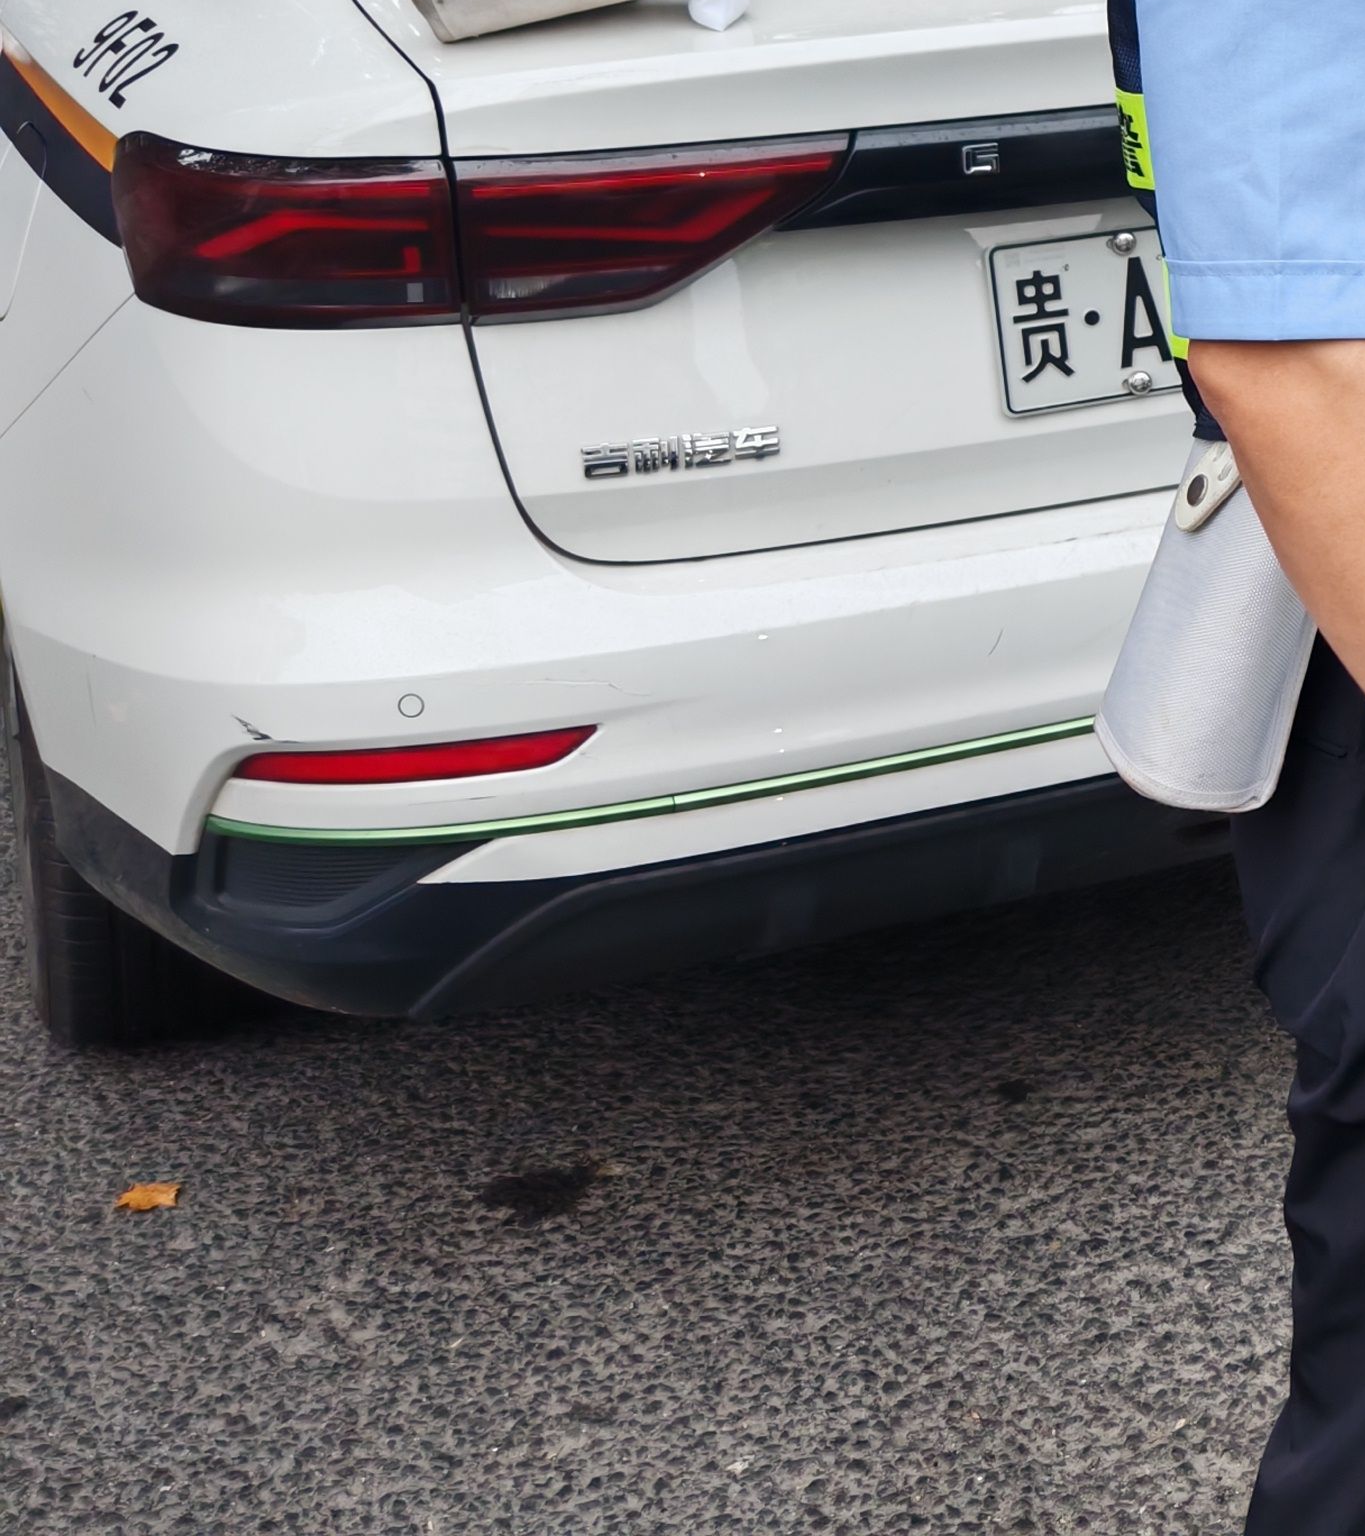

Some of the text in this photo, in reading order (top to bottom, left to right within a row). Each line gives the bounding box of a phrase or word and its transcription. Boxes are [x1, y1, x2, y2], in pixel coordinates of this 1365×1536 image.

[73, 10, 179, 109] 9F02
[581, 425, 780, 479] 吉利汽车
